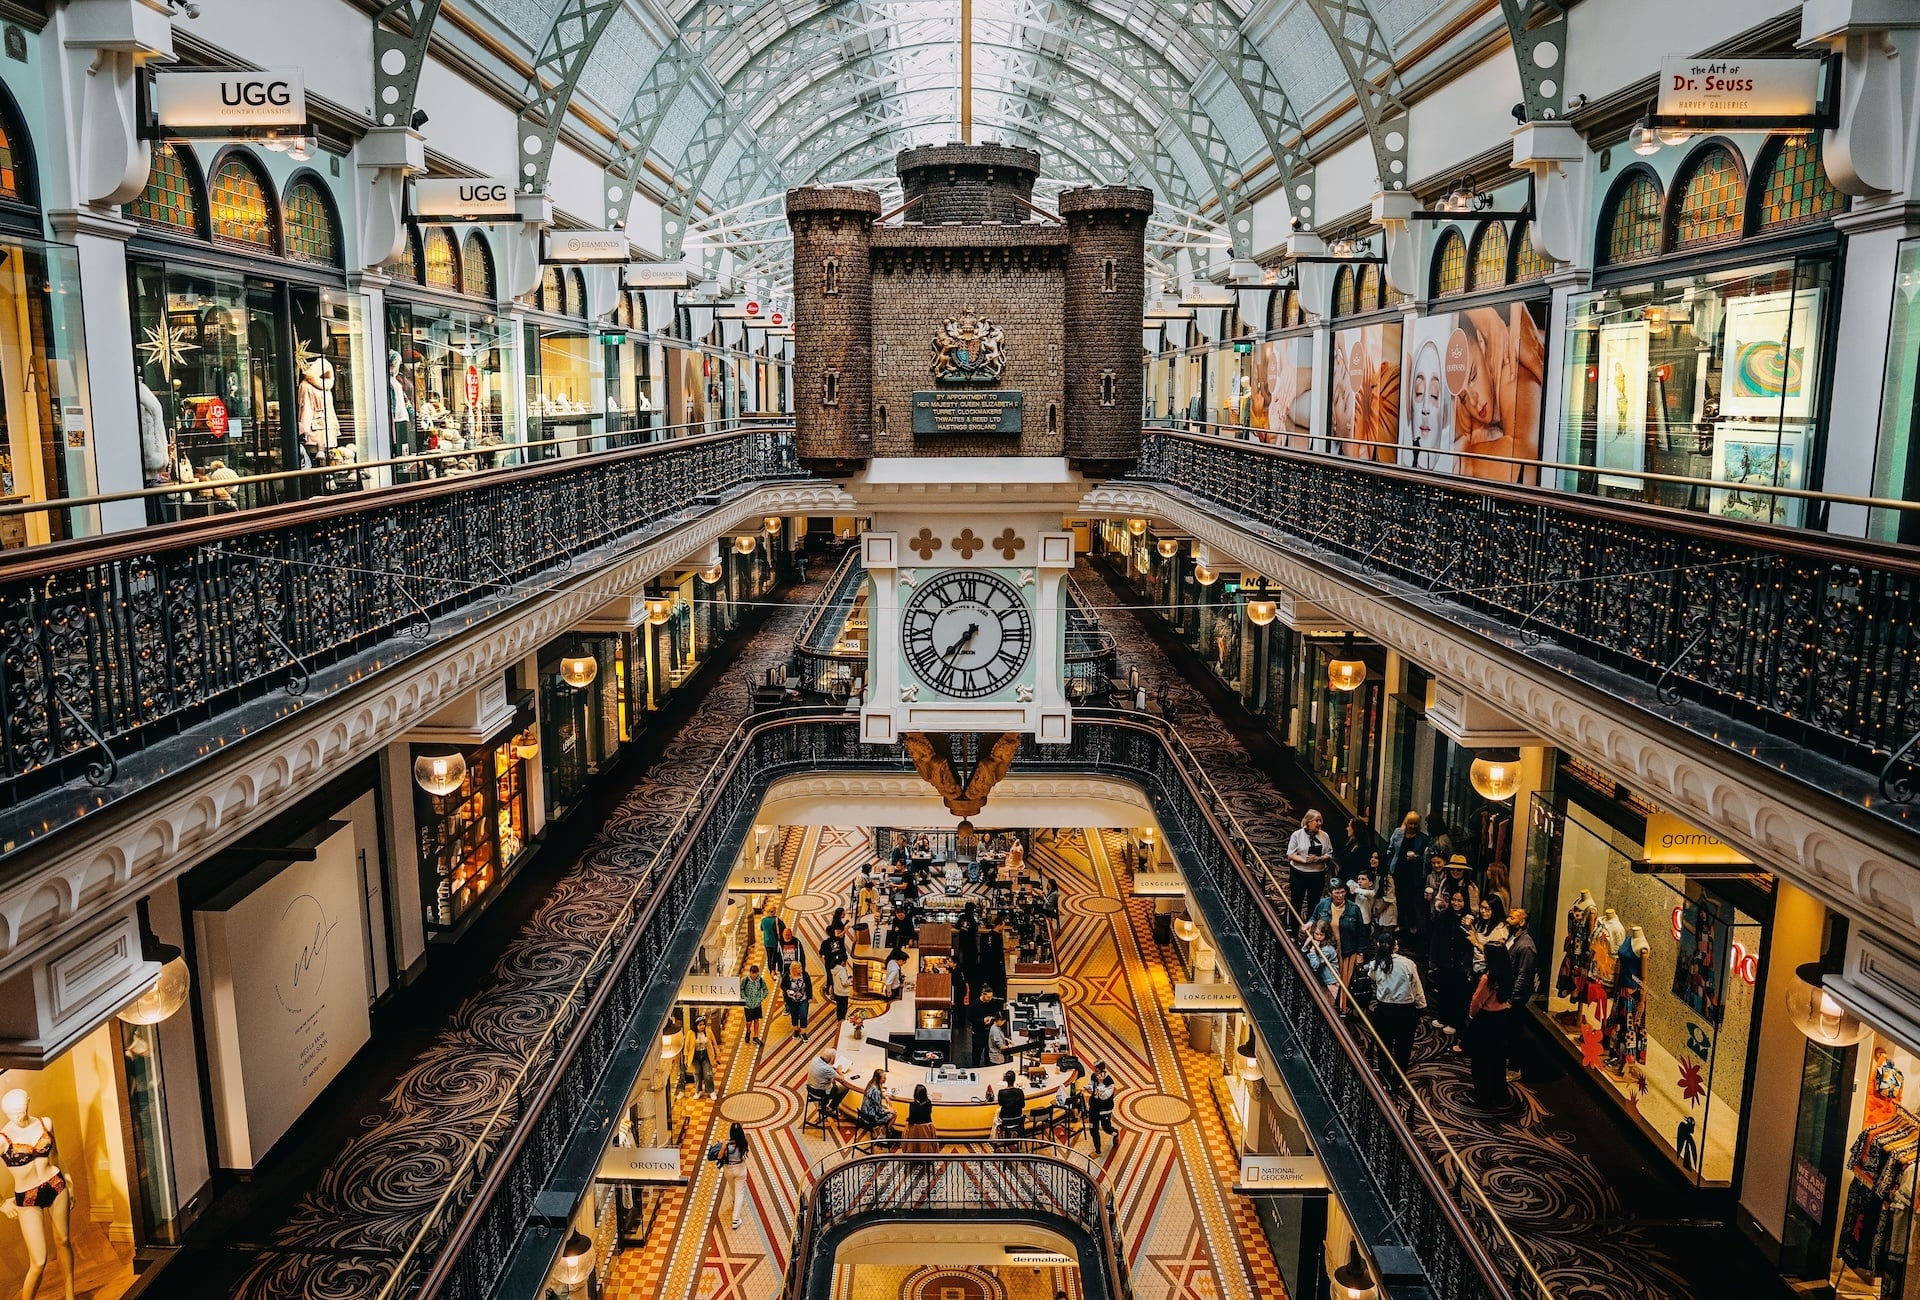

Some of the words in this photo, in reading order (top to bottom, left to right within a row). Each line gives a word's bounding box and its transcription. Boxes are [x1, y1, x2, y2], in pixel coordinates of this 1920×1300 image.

[1690, 66, 1706, 75] The
[1708, 63, 1727, 74] Art
[1729, 66, 1740, 74] of
[1673, 75, 1698, 91] Dr.
[1705, 75, 1753, 92] Seuss
[220, 82, 291, 106] UGG
[1678, 101, 1706, 109] HARVEY
[1709, 101, 1749, 109] GALLERIES
[460, 185, 507, 201] UGG
[1662, 834, 1722, 849] gorma
[691, 984, 736, 995] FURLA
[630, 1161, 675, 1170] OROTON
[1797, 1163, 1809, 1180] WE
[1809, 1175, 1825, 1194] ARE
